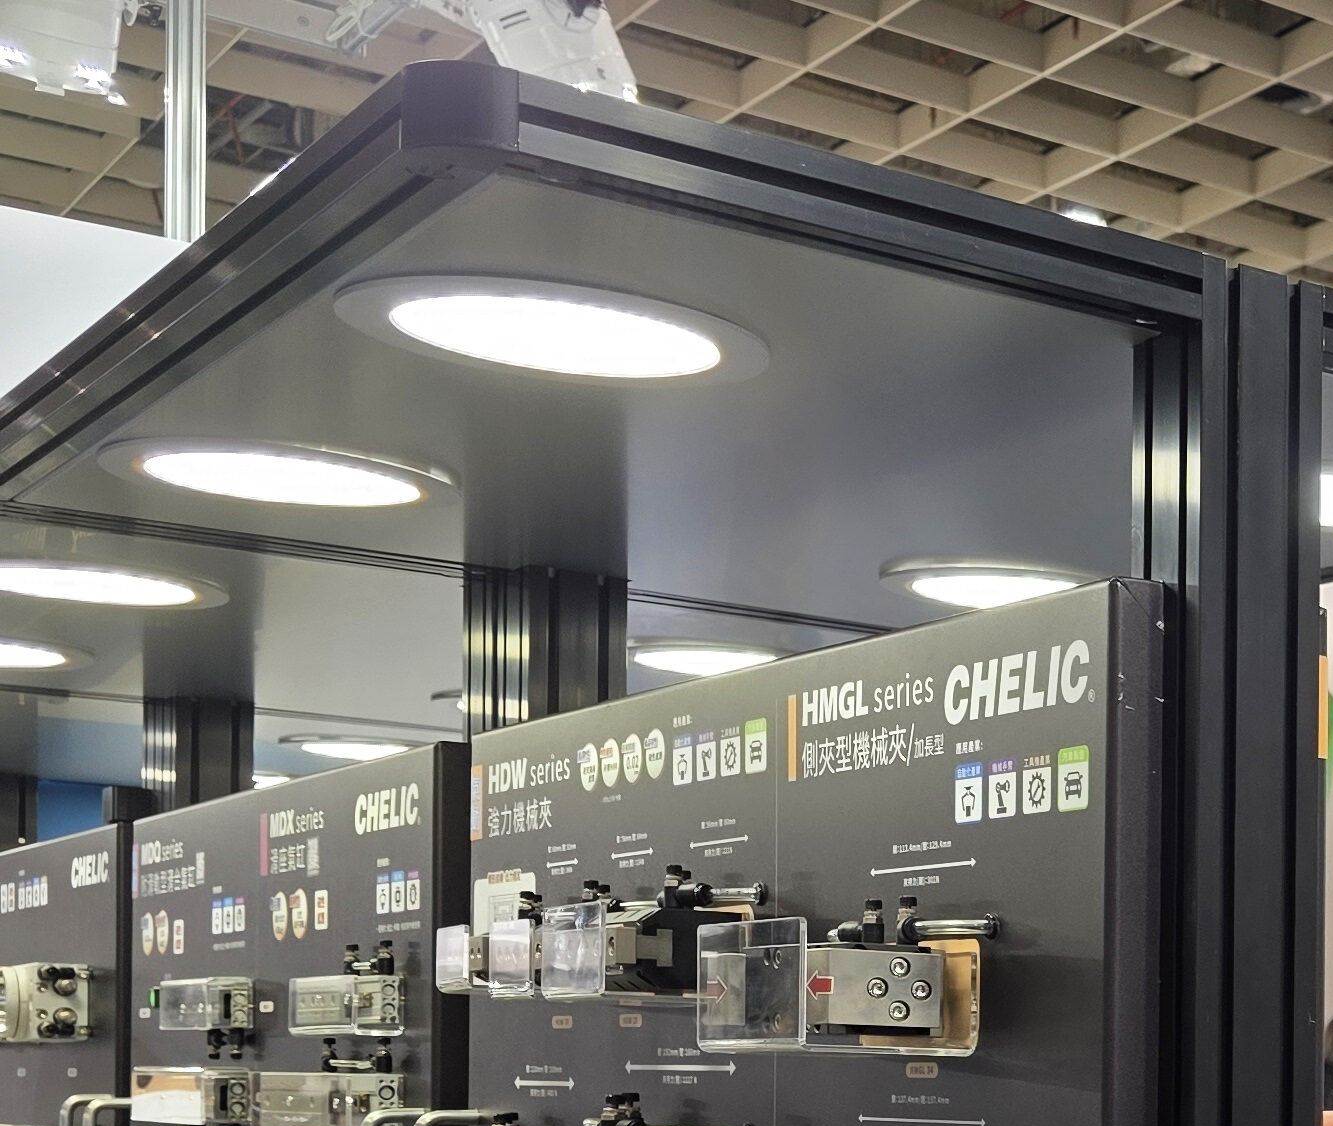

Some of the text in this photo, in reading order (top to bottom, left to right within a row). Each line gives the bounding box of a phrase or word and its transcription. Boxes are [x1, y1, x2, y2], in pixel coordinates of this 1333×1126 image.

[801, 672, 935, 726] HMGL series
[487, 757, 528, 795] HDW
[529, 753, 571, 787] series
[269, 806, 325, 838] MDX series
[487, 796, 553, 838] 強力機械夾
[70, 850, 109, 889] CHELIC
